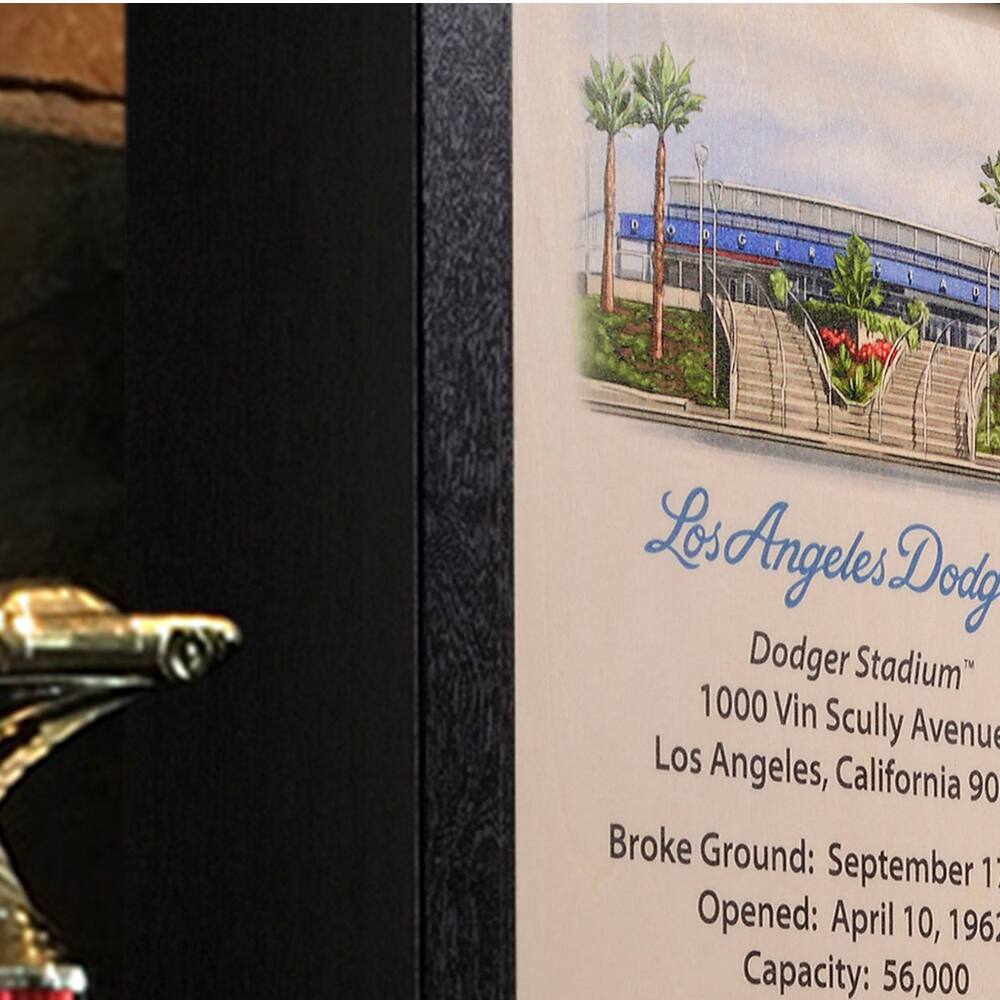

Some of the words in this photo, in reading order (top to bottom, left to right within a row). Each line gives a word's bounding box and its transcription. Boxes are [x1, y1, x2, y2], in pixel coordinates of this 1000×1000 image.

[644, 487, 722, 569] Los
[724, 501, 887, 608] Angeles
[750, 631, 850, 682] Dodger
[855, 645, 962, 690] Stadium
[701, 684, 768, 724] 1000
[774, 691, 817, 730] Vin
[826, 697, 905, 748] Scully
[655, 735, 702, 775] Los
[710, 742, 829, 793] Angeles,
[836, 755, 961, 801] California
[609, 823, 693, 866] Broke
[700, 832, 815, 875] Ground:
[829, 842, 974, 889] September
[698, 889, 818, 936] Opened:
[831, 899, 894, 944] April
[904, 905, 941, 945] 10,
[743, 950, 870, 1000] Capacity:
[883, 959, 970, 999] 56,000
